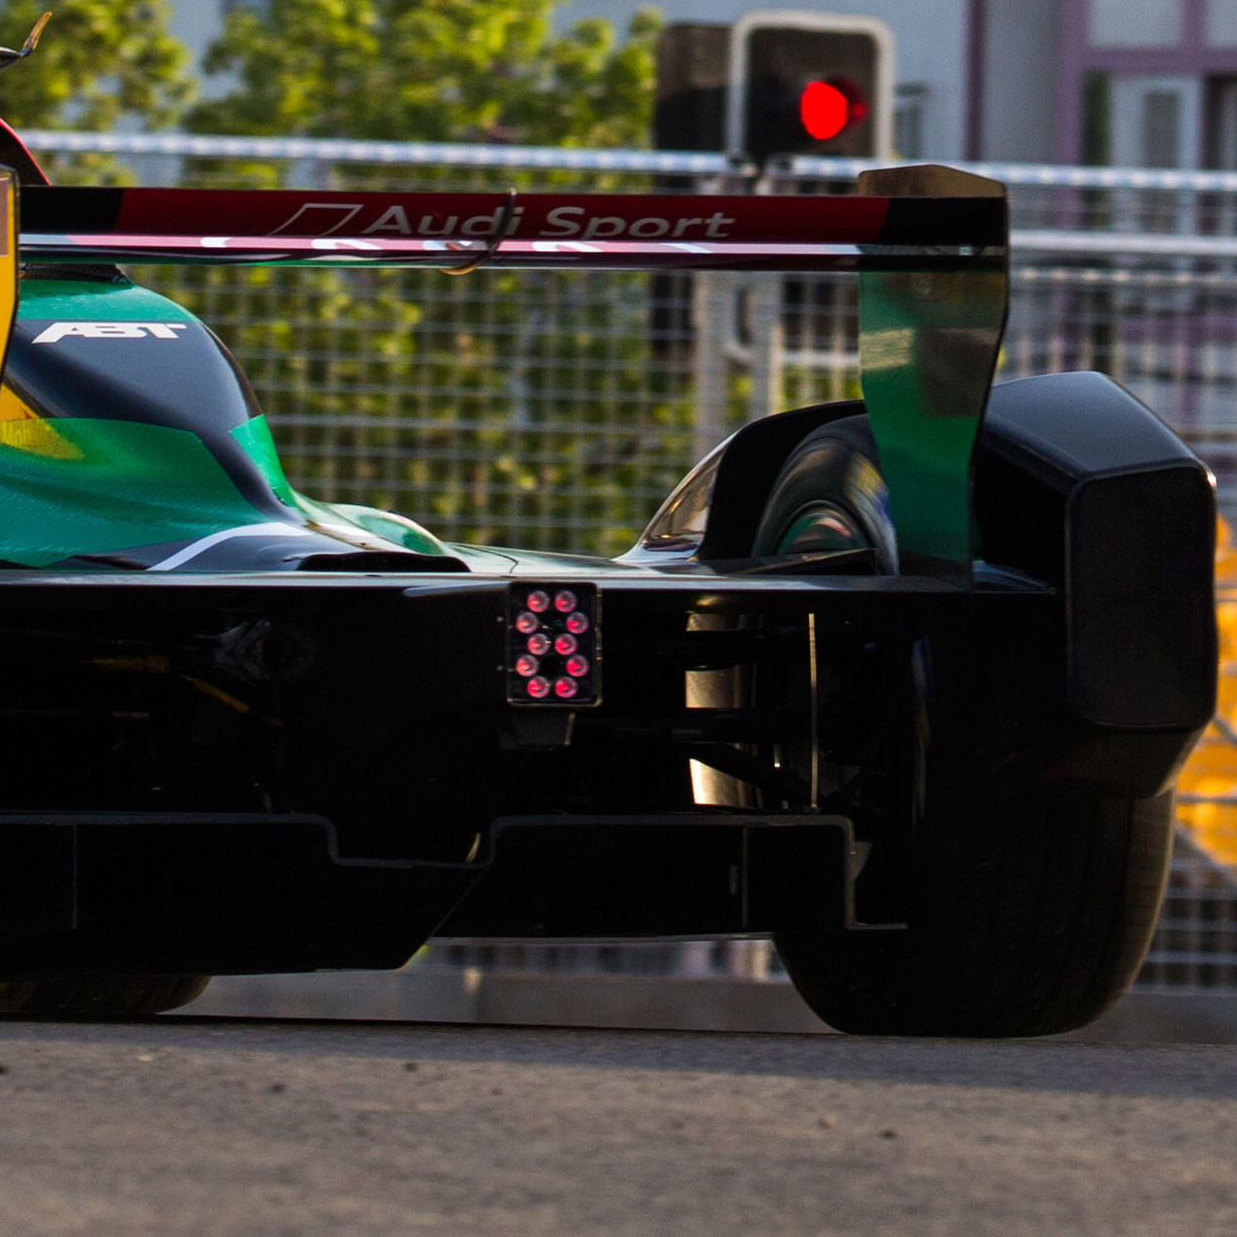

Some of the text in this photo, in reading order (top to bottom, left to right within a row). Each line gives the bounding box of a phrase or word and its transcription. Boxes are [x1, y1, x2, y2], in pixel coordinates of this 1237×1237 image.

[363, 206, 735, 239] Audi Sport
[31, 322, 187, 345] ABT
